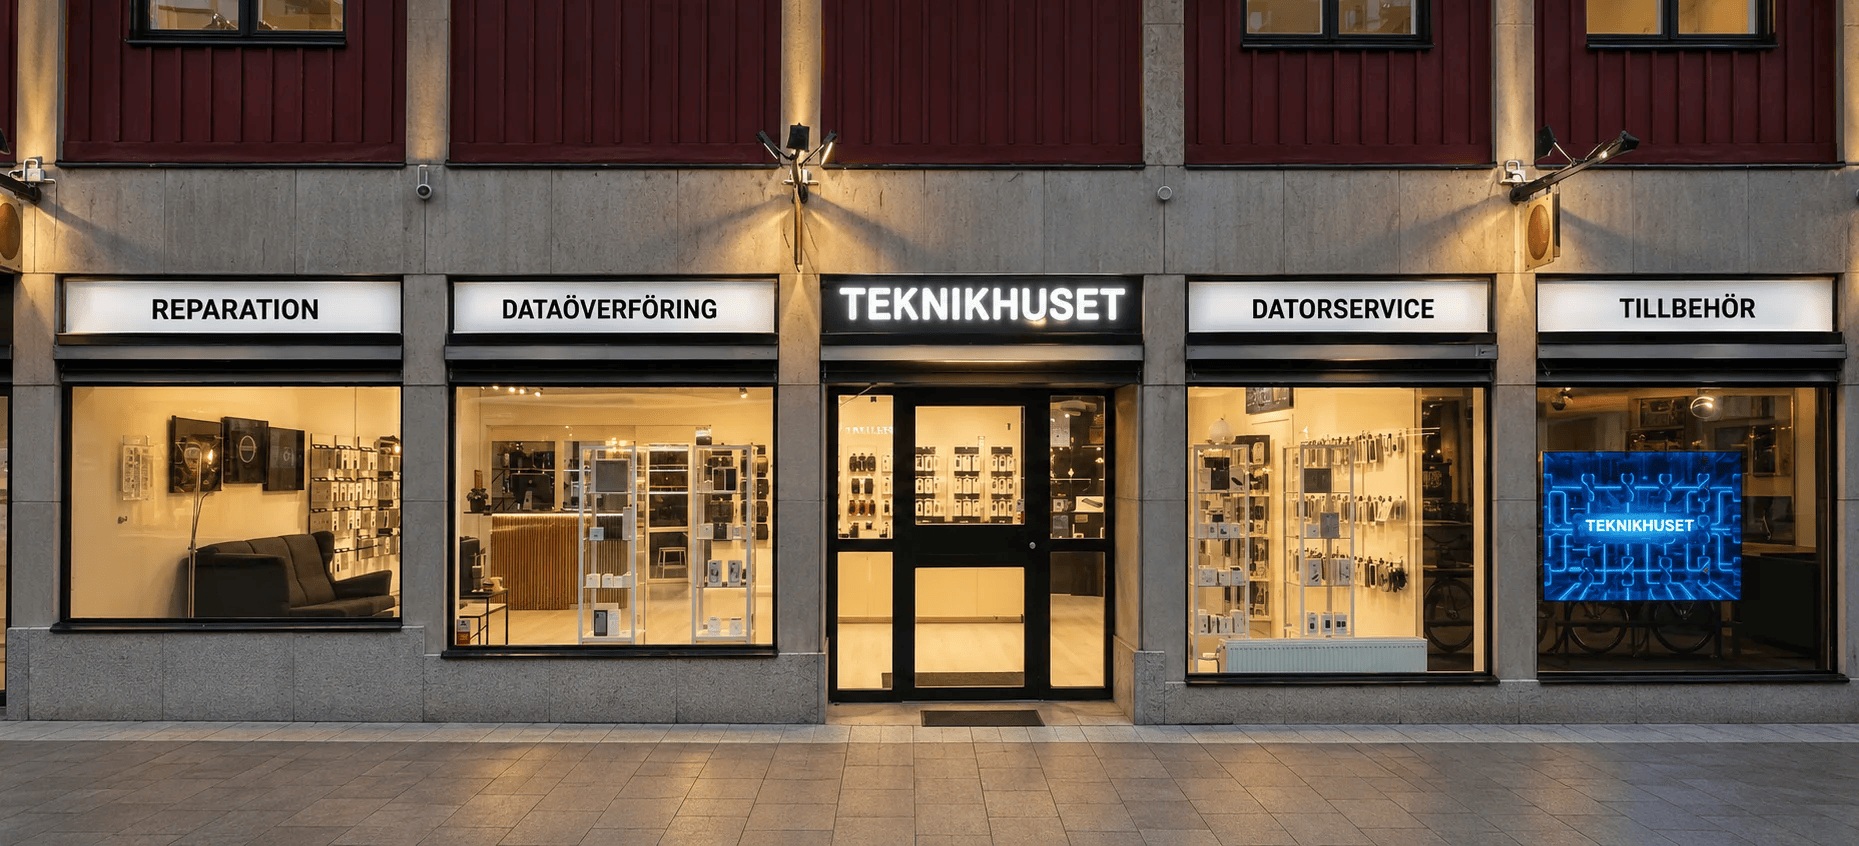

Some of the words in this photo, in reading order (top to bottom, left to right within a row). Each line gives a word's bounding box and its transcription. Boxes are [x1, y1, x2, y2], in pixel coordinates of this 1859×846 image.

[152, 298, 319, 320] REPARATION
[502, 294, 717, 320] DATAÖVERFÖRING
[838, 287, 1126, 321] TEKNIKHUSET
[1252, 298, 1434, 320] DATORSERVICE
[1619, 293, 1756, 319] TILLBEHÖR
[1585, 518, 1694, 532] TEKNIKHUSET
